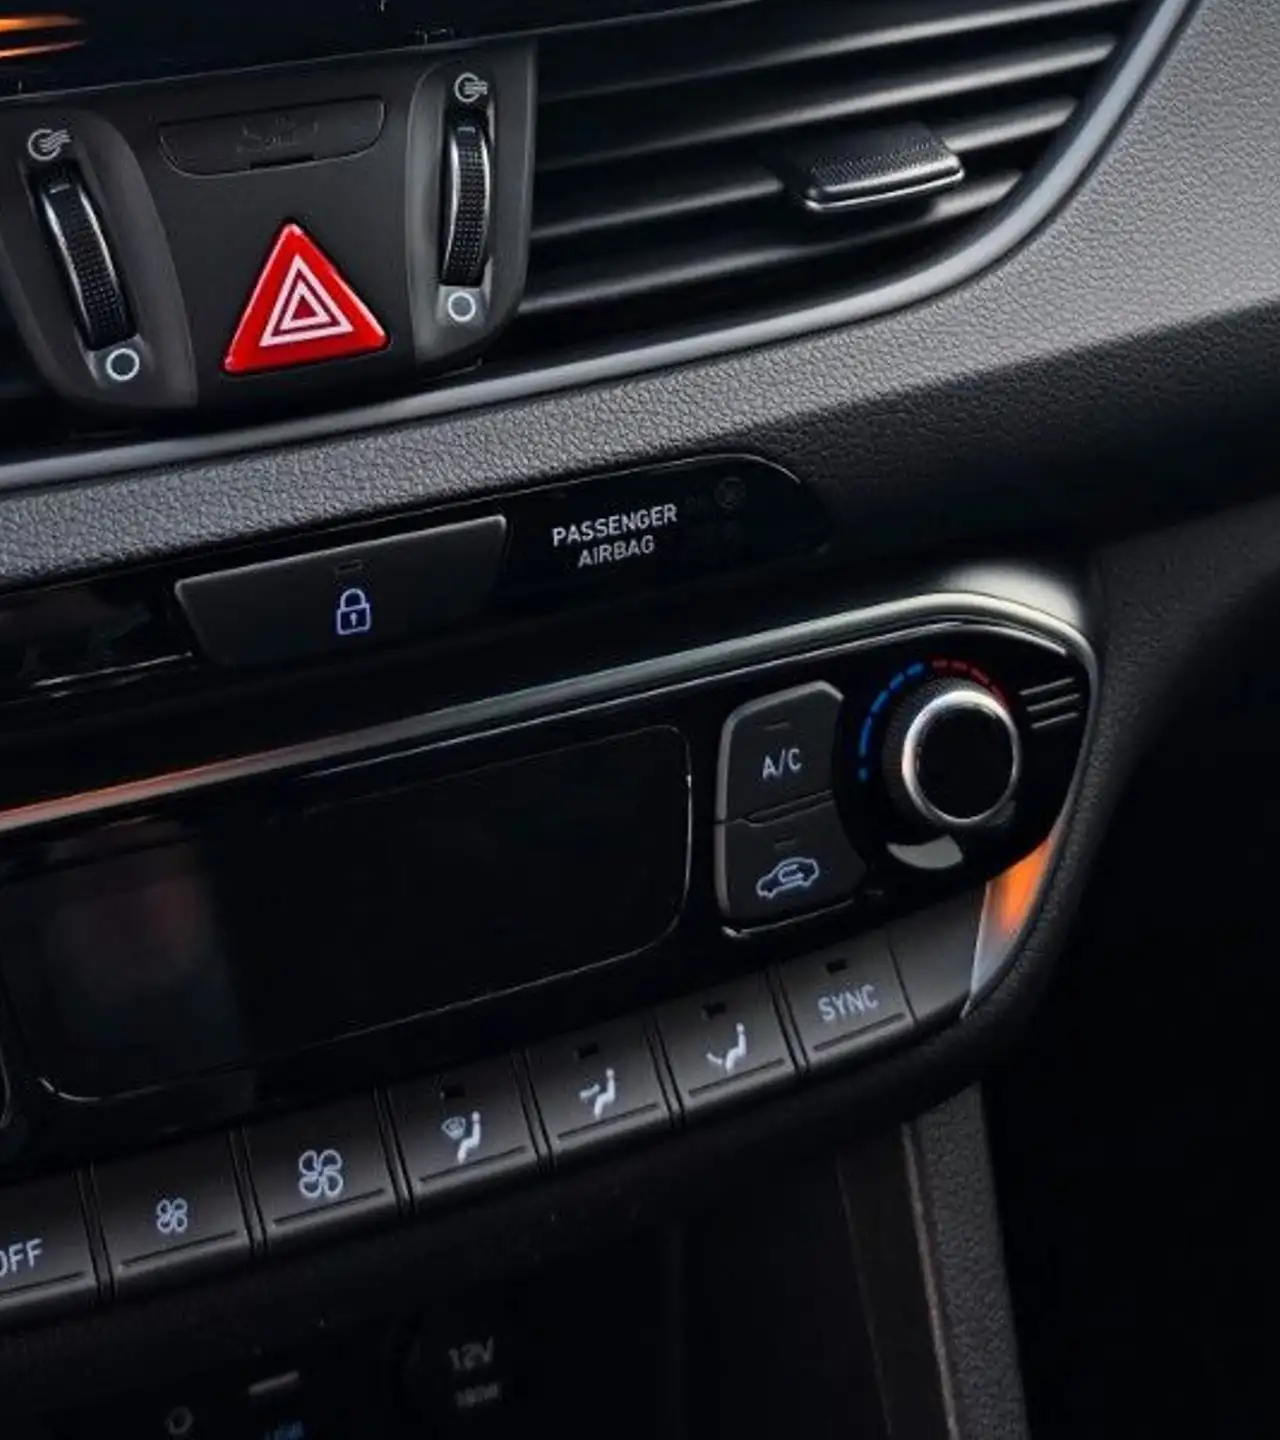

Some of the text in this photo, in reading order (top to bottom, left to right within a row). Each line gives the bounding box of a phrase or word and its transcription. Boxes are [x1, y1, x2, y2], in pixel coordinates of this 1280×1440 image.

[552, 503, 678, 547] PASSENGER
[578, 535, 656, 569] AIRBAG
[762, 748, 802, 780] A/C
[818, 984, 880, 1022] SYNC
